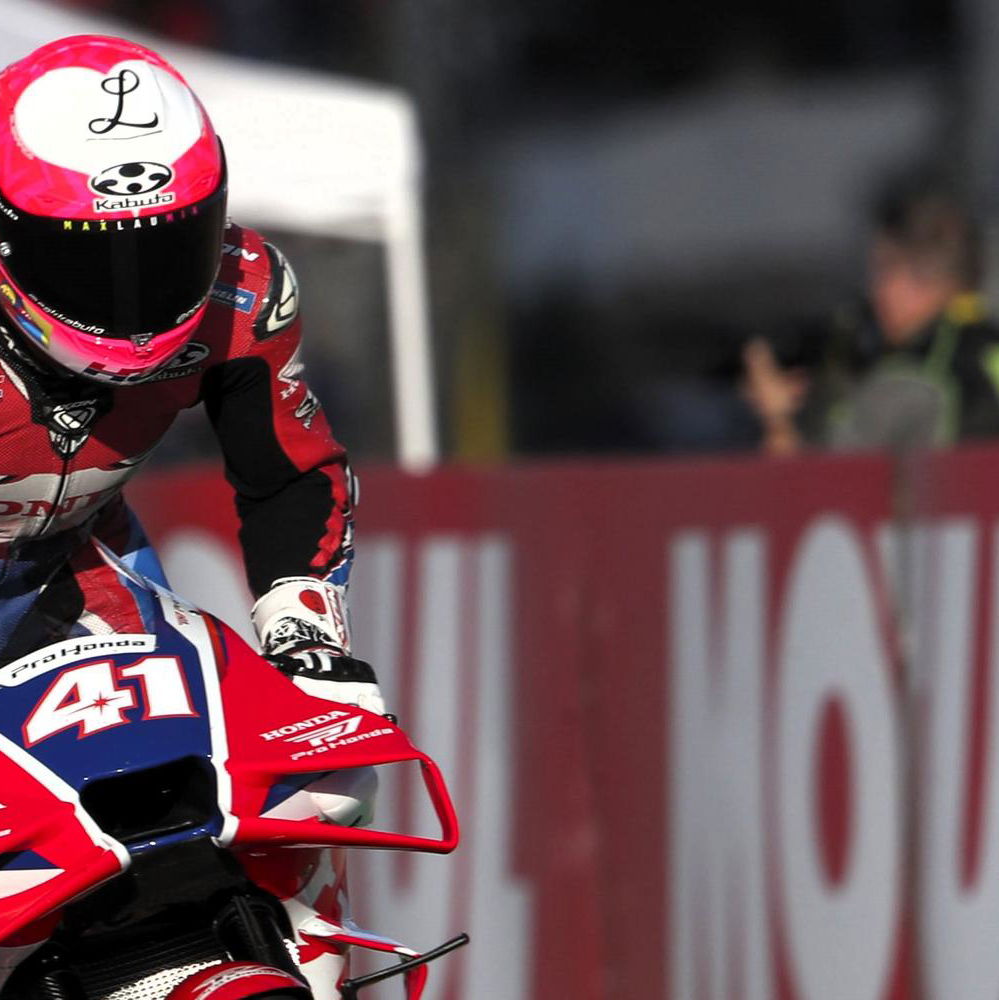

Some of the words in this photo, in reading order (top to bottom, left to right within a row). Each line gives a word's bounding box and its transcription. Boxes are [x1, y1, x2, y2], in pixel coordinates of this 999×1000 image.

[96, 193, 173, 211] Kabuto
[21, 655, 201, 749] 41
[259, 710, 352, 741] HONDA
